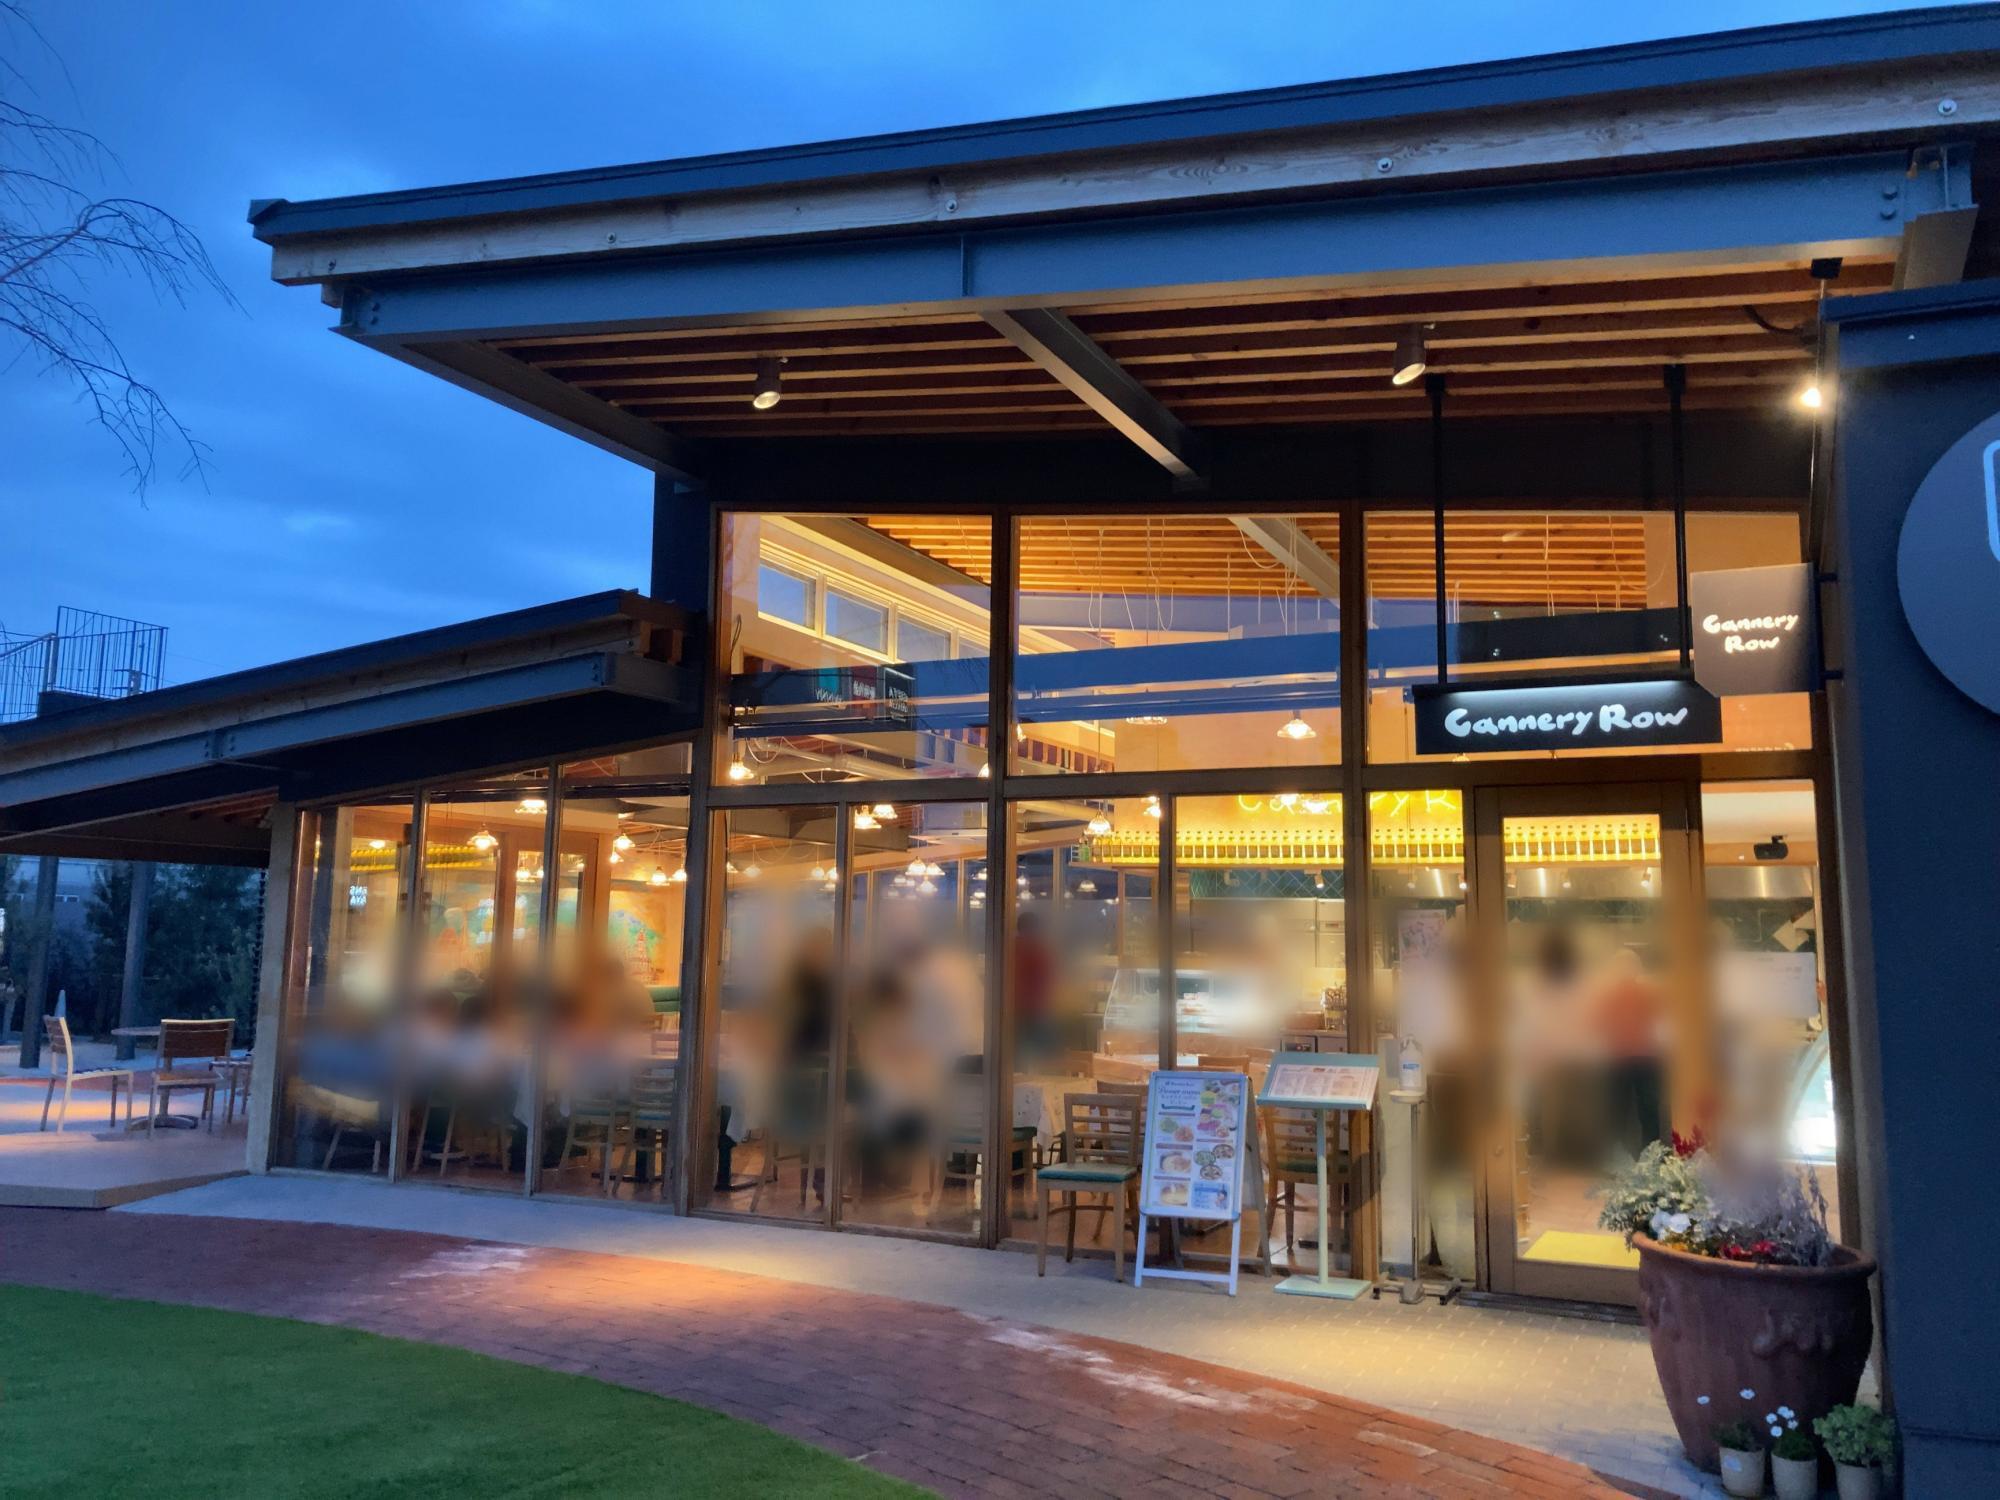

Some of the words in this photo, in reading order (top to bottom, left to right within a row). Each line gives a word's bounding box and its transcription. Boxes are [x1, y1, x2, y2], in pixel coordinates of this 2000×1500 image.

[1702, 613, 1799, 635] Cannery
[1724, 634, 1780, 654] Row
[1444, 707, 1594, 738] Cannery
[1599, 702, 1689, 733] Row
